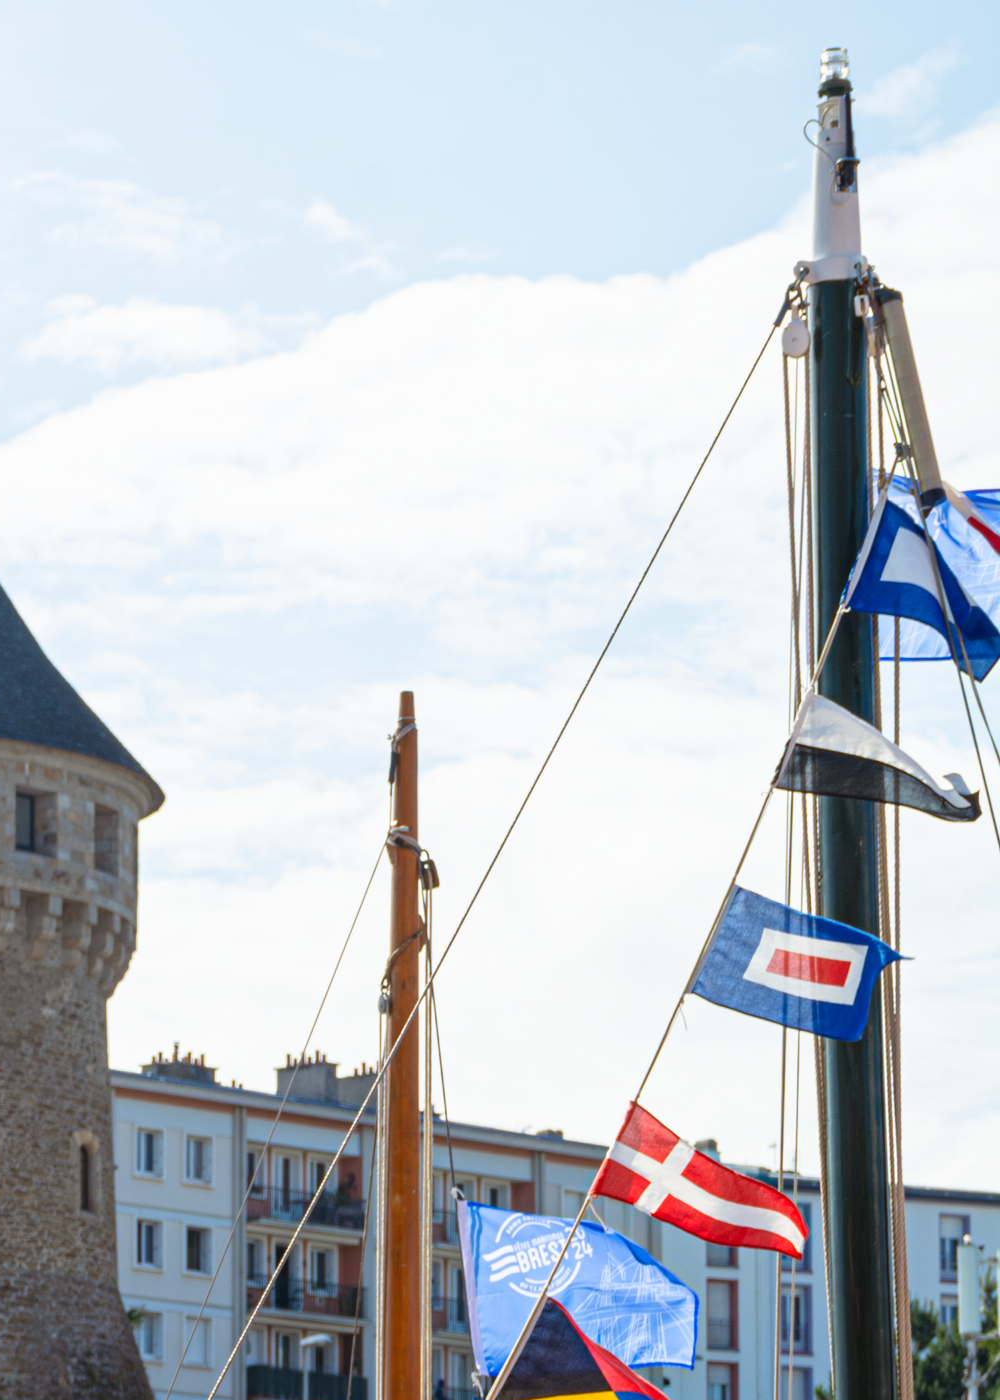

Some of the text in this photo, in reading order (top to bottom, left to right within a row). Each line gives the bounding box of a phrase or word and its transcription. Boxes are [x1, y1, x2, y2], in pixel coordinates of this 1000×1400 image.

[531, 1231, 565, 1247] MARITIMES
[571, 1239, 594, 1260] 24
[516, 1237, 569, 1274] BREST
